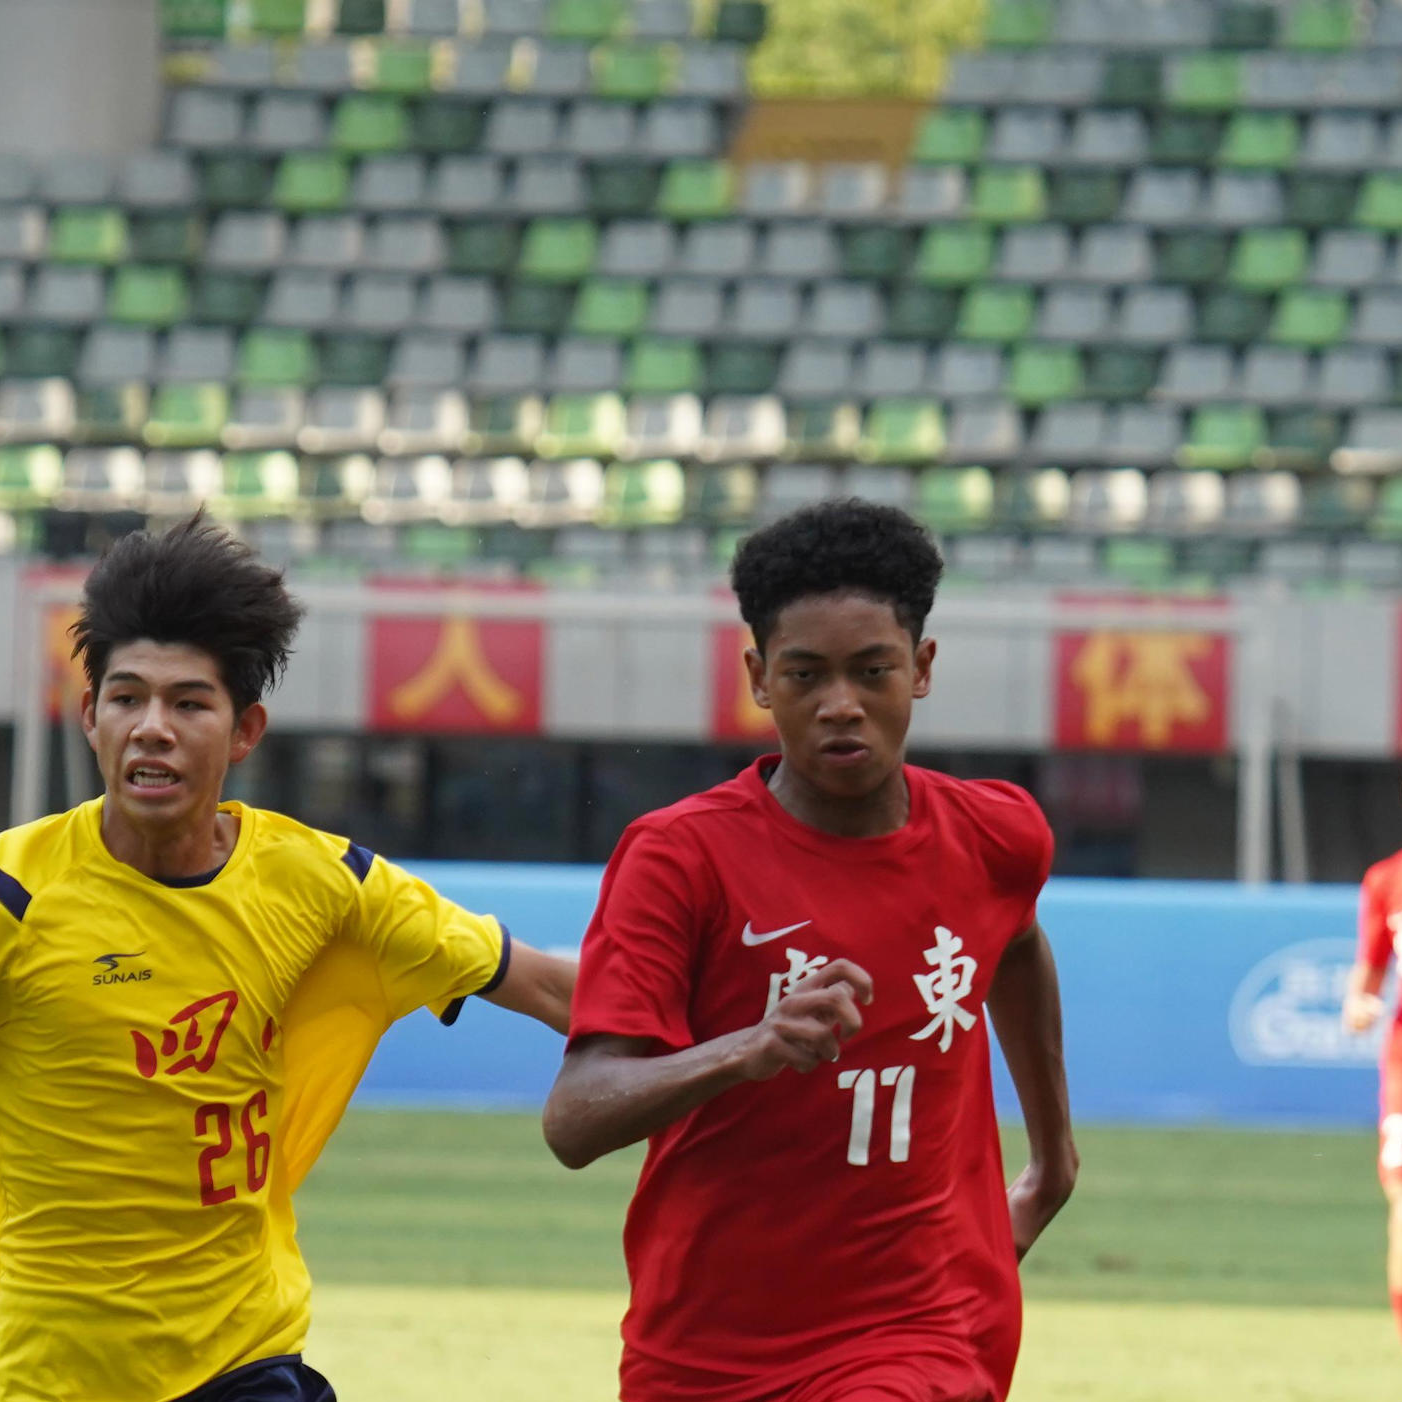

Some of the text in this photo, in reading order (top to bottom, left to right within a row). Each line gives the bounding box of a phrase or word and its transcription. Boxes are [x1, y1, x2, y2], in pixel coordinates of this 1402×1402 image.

[392, 588, 522, 724] 人
[1072, 608, 1210, 748] 体
[92, 969, 153, 986] SUNAIS
[194, 1088, 270, 1207] 26
[837, 1064, 916, 1167] 11
